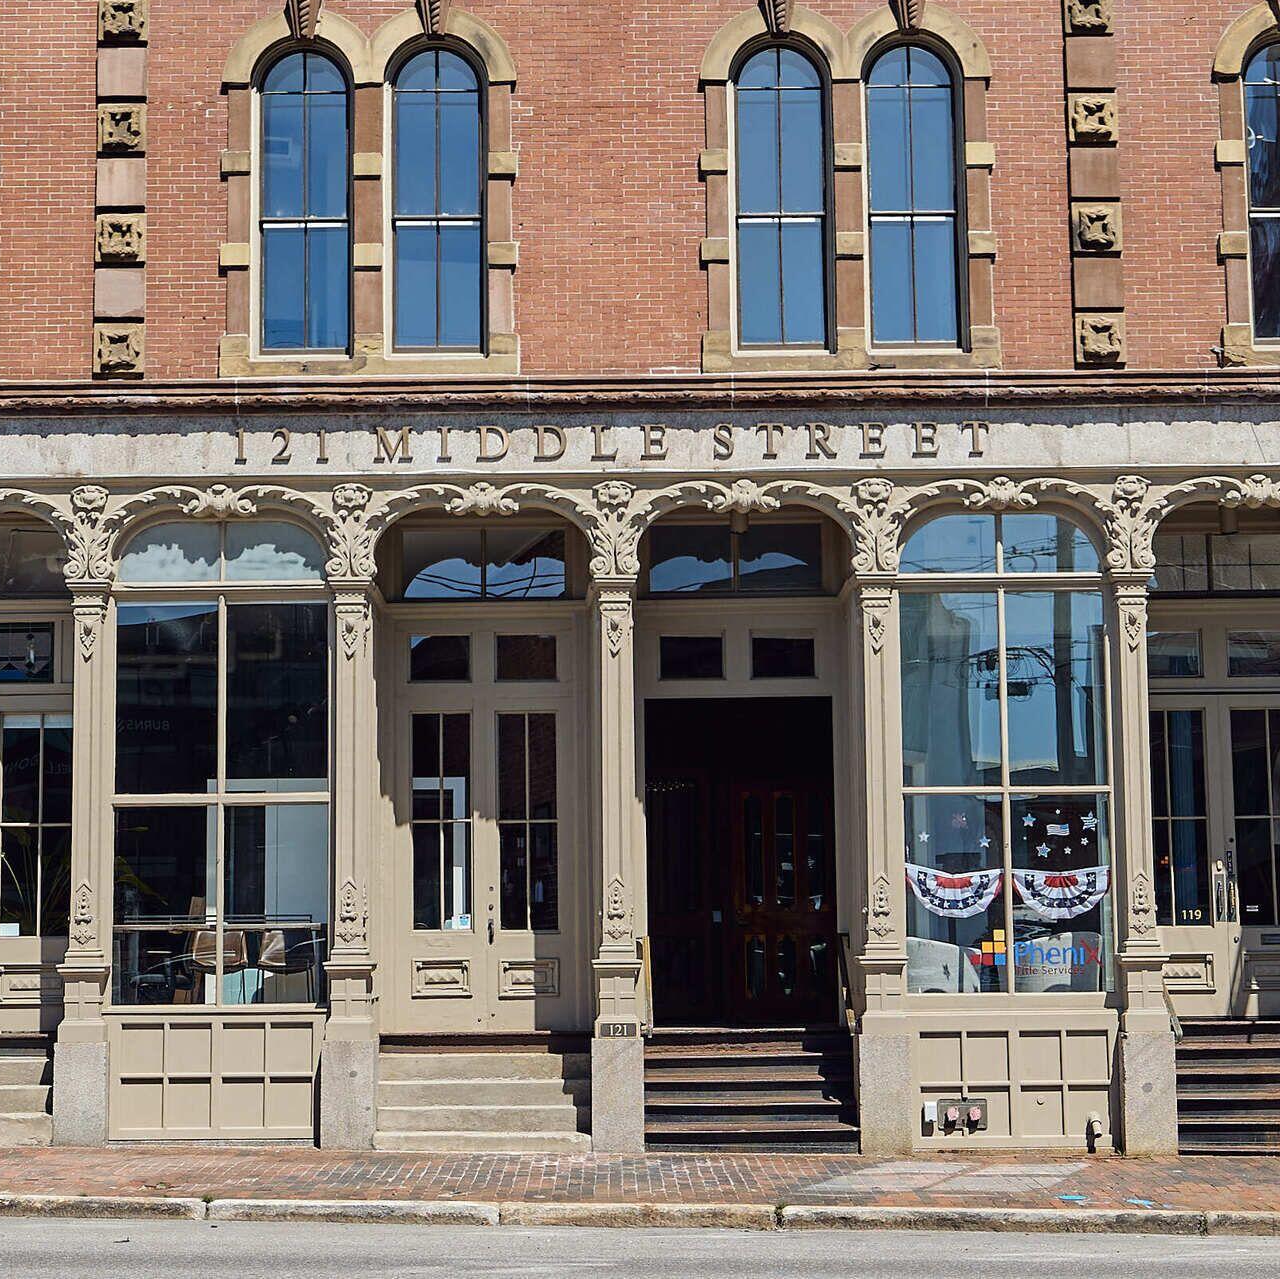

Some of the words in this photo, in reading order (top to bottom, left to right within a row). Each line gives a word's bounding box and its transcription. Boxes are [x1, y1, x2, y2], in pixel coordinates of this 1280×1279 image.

[235, 428, 329, 465] 121
[373, 424, 669, 463] MIDDLE
[712, 421, 990, 461] STREET
[1181, 909, 1202, 920] 119
[1015, 966, 1038, 975] Title
[1042, 966, 1085, 975] Services
[609, 1024, 628, 1036] 121
